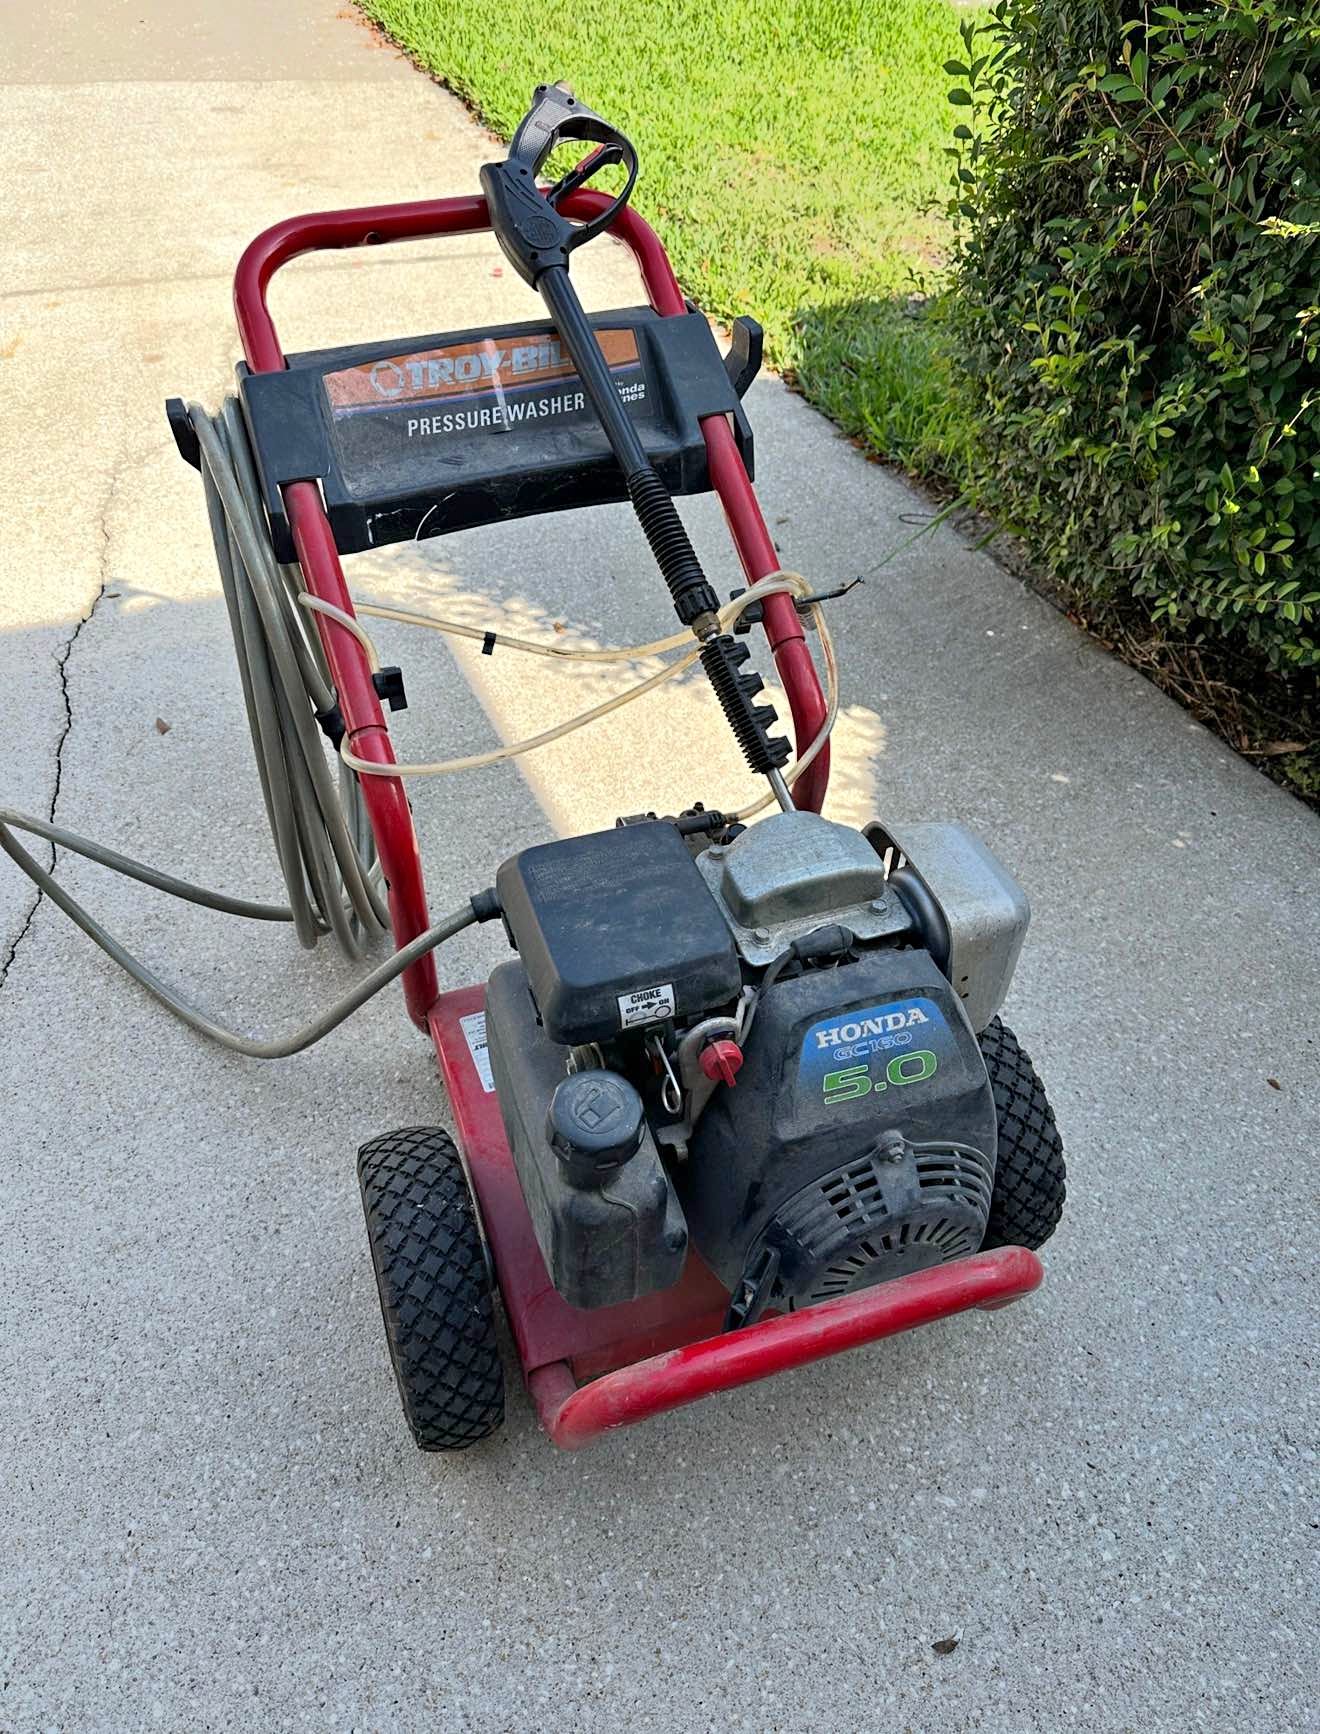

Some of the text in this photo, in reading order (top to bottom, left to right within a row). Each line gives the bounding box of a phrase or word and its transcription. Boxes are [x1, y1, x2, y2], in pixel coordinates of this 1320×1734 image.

[405, 340, 572, 390] TROY-BIL
[408, 392, 585, 437] PRESSURE WASHER
[625, 1006, 640, 1014] OFF
[630, 988, 662, 1004] CHOKE
[815, 1007, 929, 1049] HONDA
[833, 1031, 913, 1061] GC160
[822, 1050, 938, 1105] 5.0
